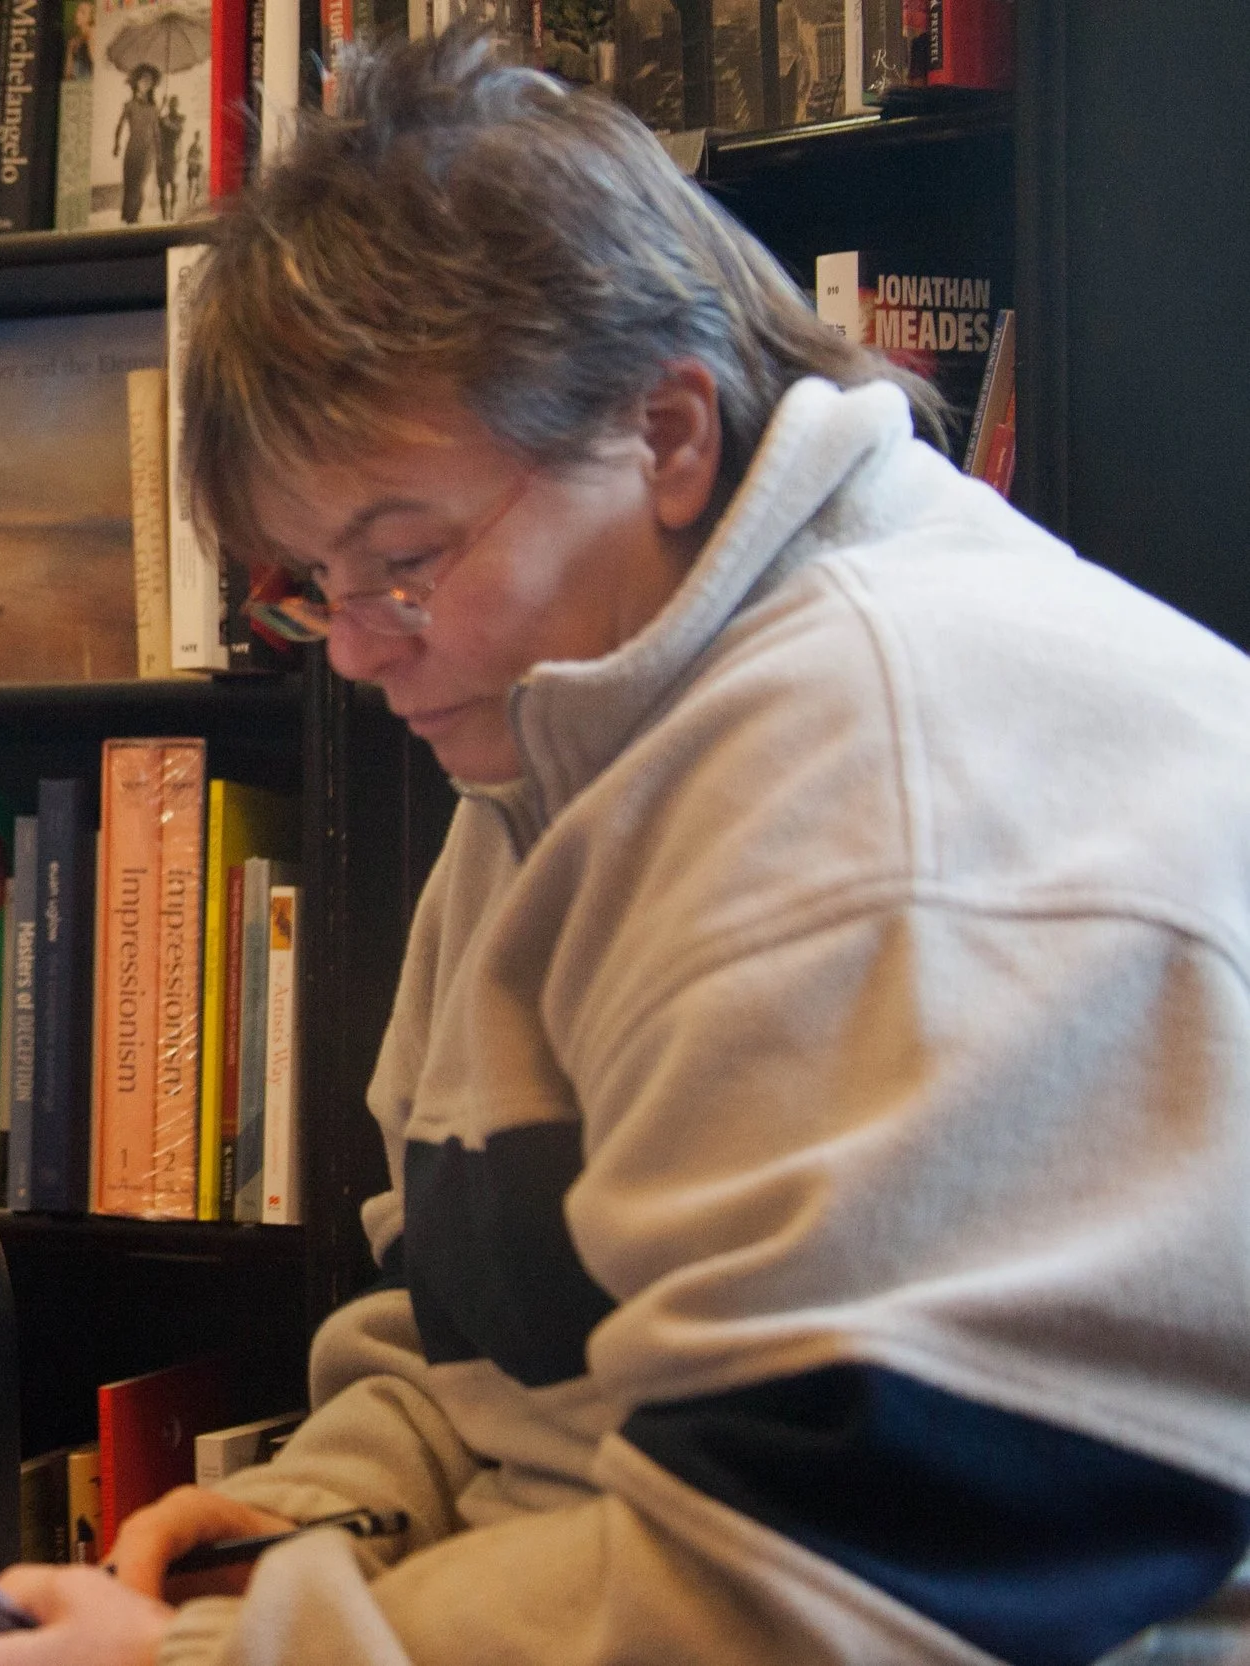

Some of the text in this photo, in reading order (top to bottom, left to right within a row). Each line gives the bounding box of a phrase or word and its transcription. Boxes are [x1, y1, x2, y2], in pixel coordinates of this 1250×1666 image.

[930, 12, 939, 64] PRESTEL
[827, 286, 840, 296] 010
[875, 274, 991, 309] JONATHAN
[875, 309, 991, 353] MEADES
[15, 922, 35, 988] Masters
[15, 992, 34, 1010] of
[116, 866, 148, 1095] Impressionism
[159, 867, 193, 1097] Impressionism
